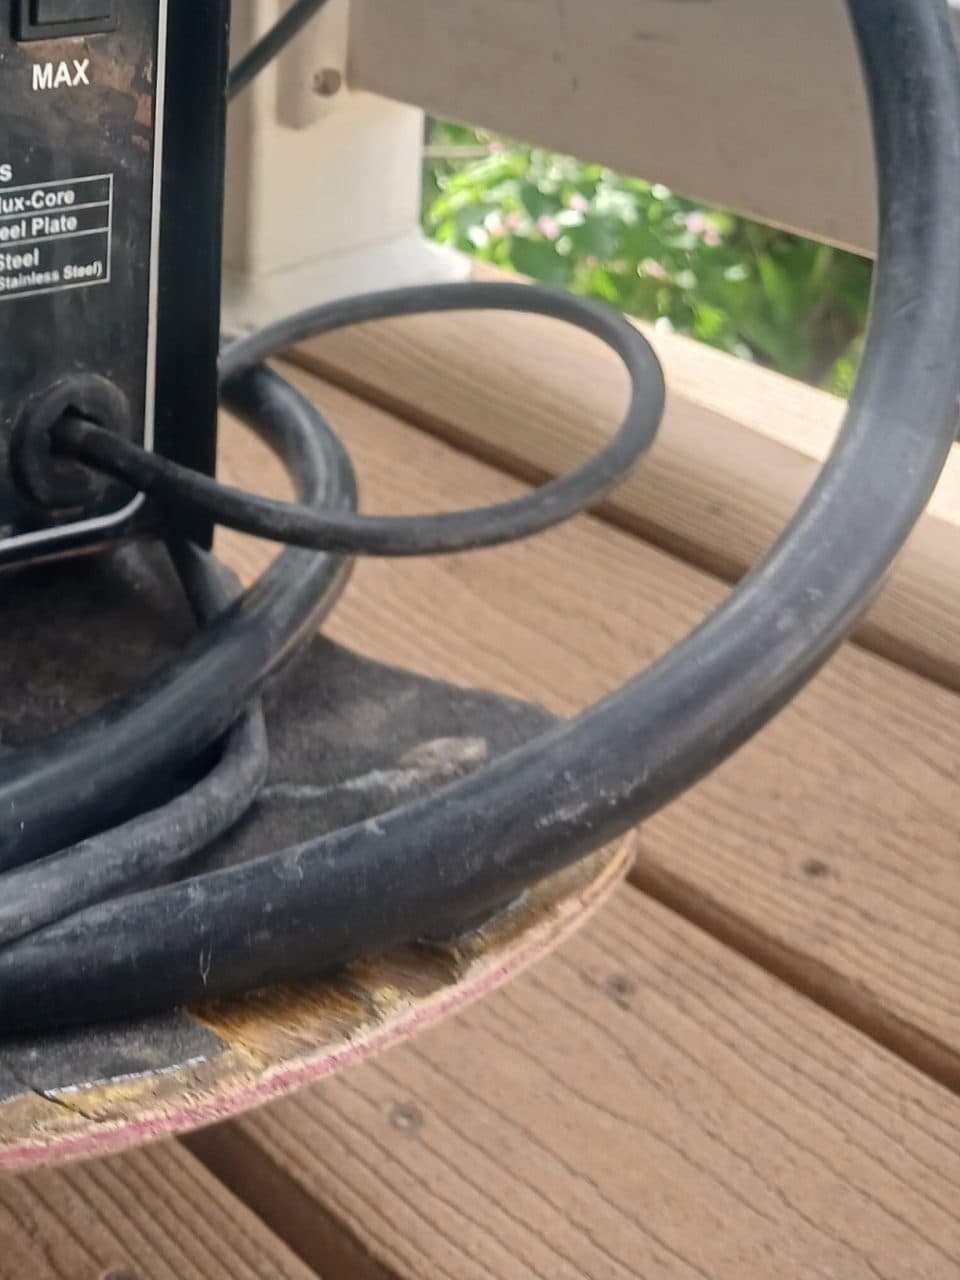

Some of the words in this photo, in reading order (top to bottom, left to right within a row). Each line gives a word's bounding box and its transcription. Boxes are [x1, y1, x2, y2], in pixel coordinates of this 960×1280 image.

[32, 59, 90, 90] MAX
[31, 215, 78, 236] Plate
[63, 261, 103, 281] Steel)
